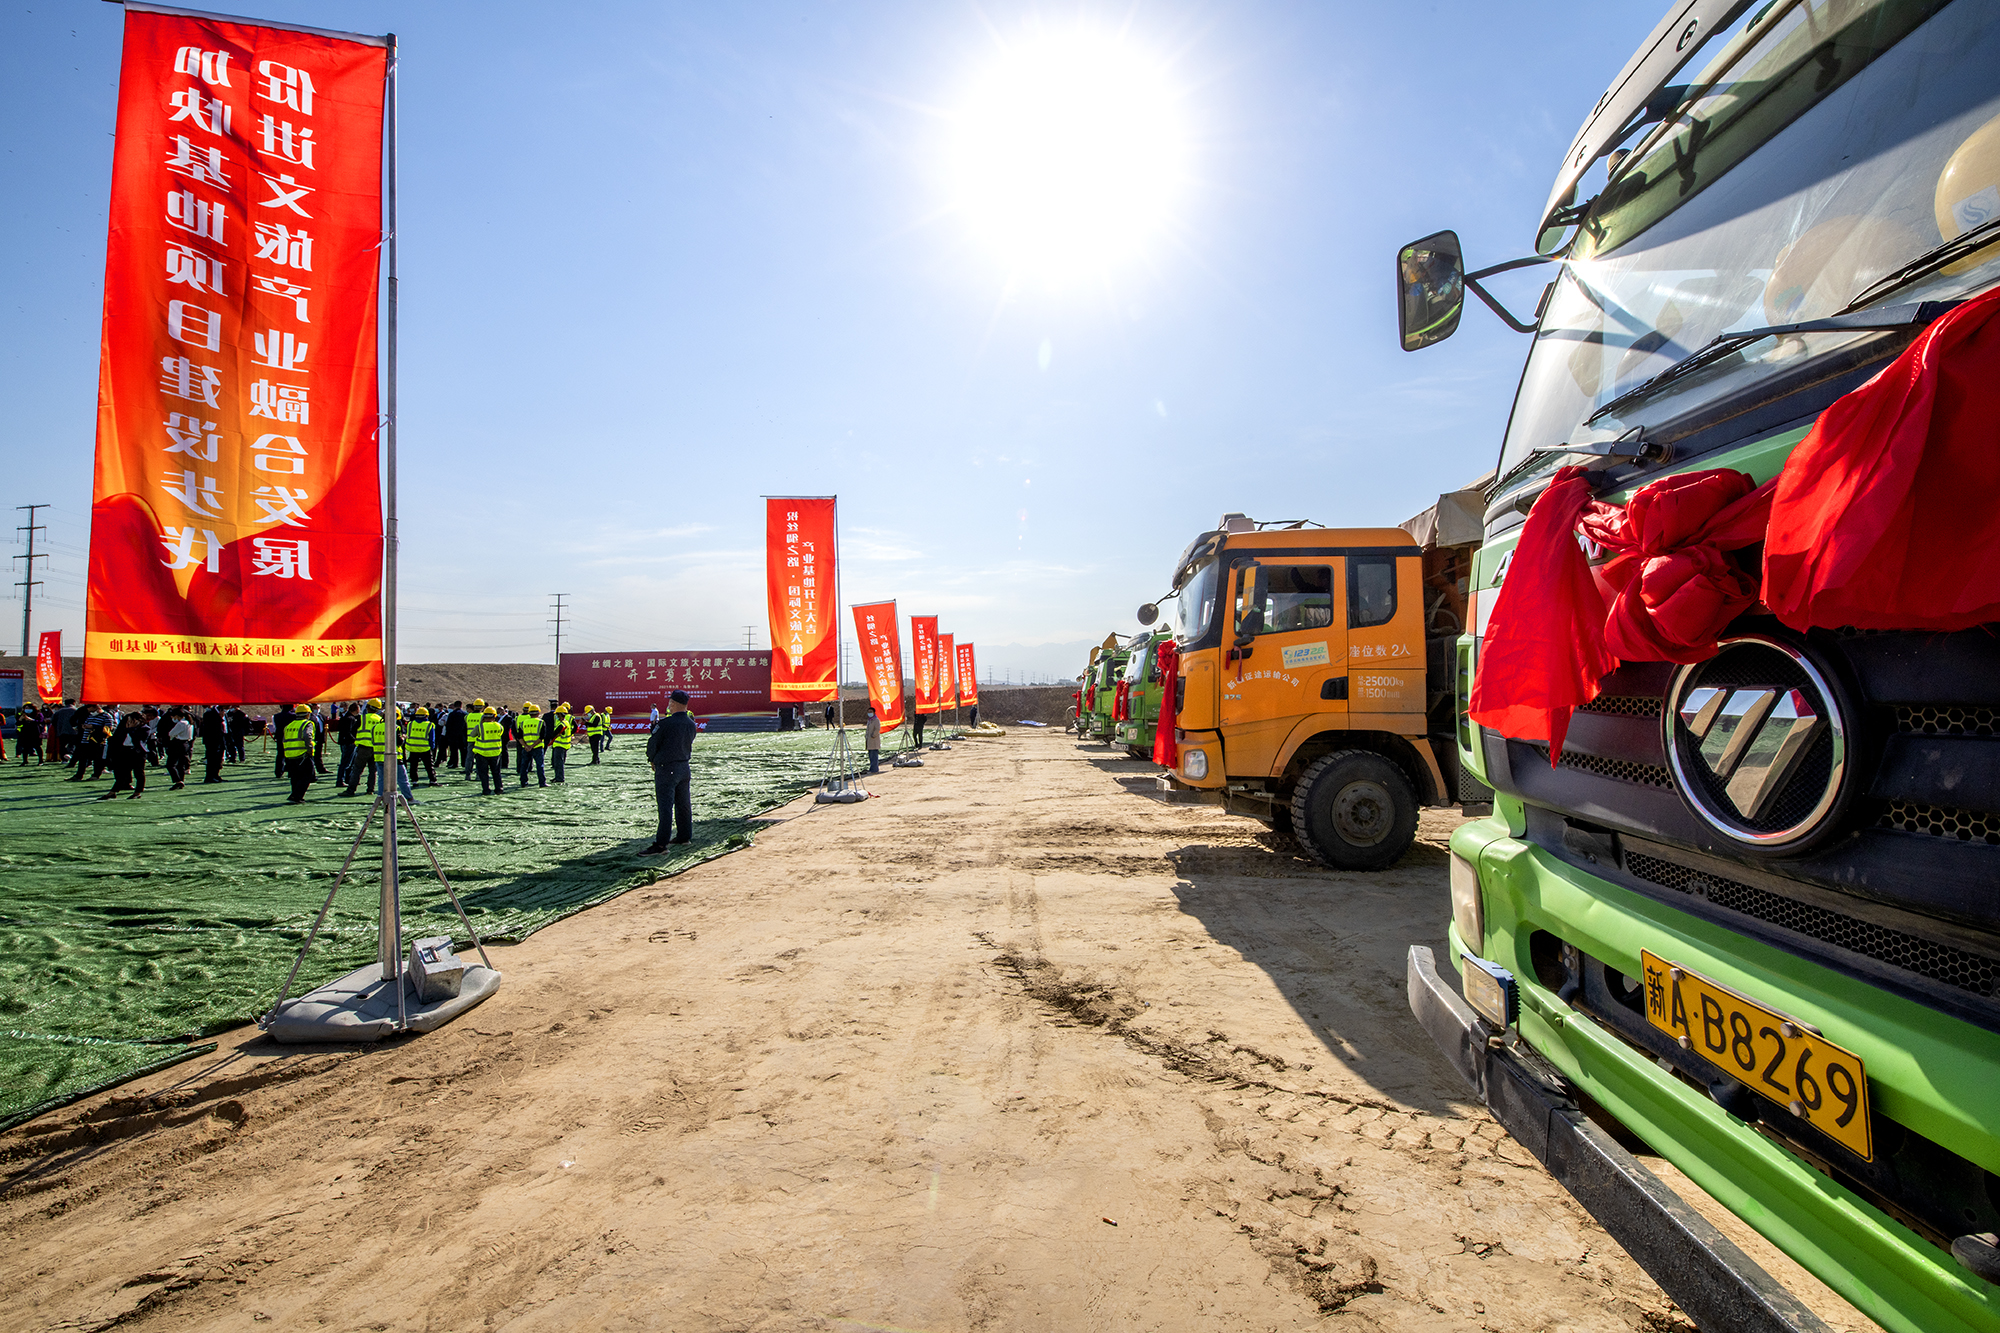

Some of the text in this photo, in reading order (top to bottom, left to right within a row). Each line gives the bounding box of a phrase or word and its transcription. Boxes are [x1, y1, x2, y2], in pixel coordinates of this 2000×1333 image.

[1349, 643, 1411, 657] 座位数 2人
[592, 658, 769, 669] 丝绸之路·国际文旅大健康产业基地
[627, 667, 732, 683] 开工奠基仪式
